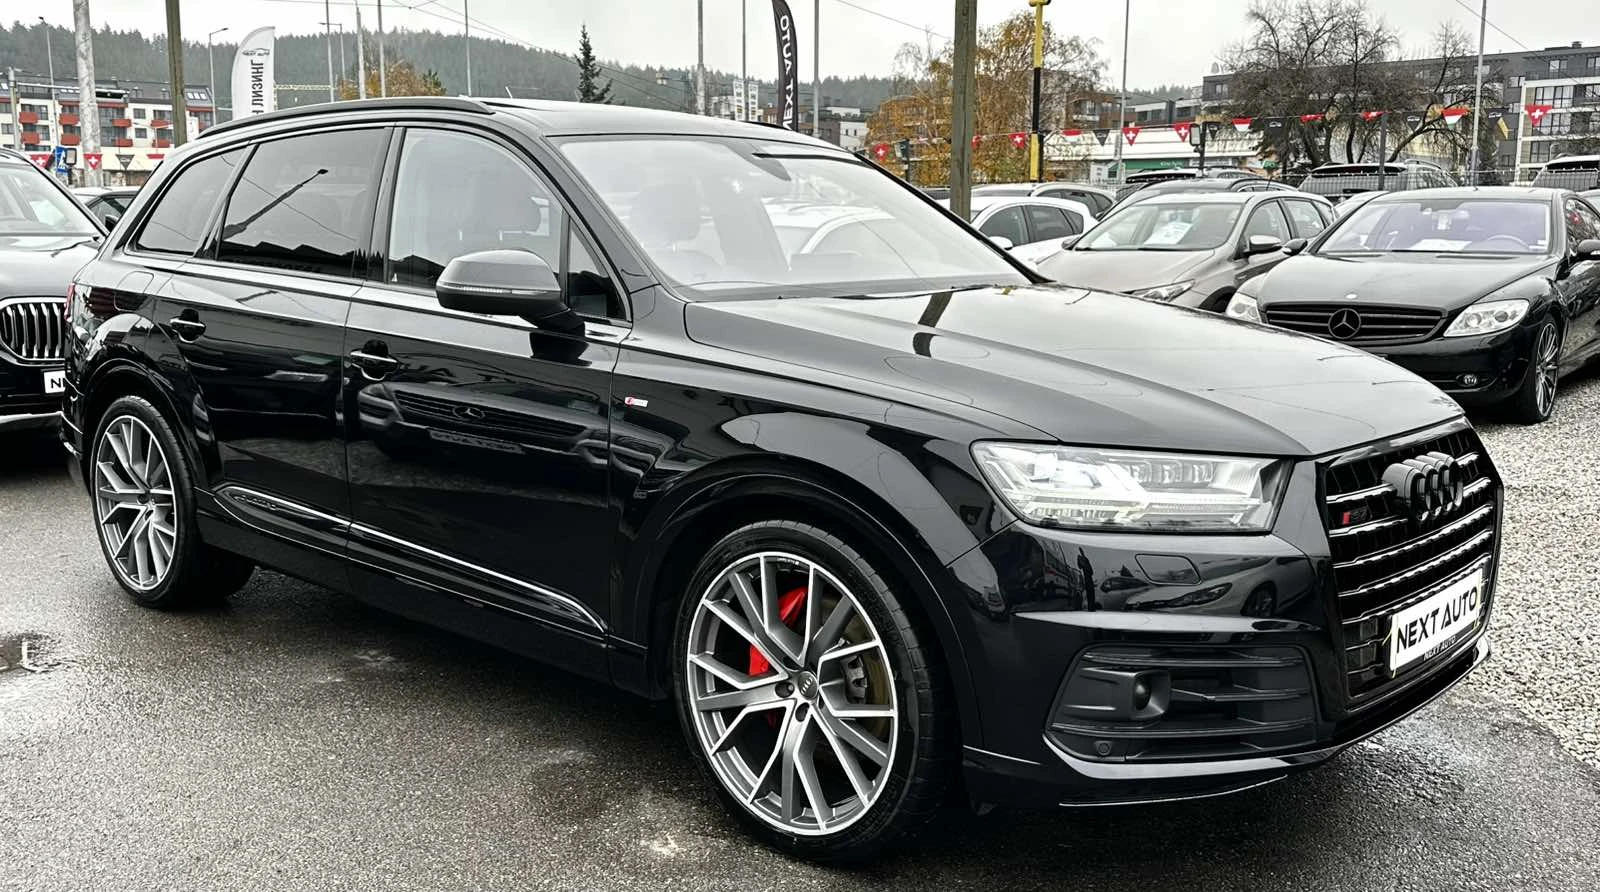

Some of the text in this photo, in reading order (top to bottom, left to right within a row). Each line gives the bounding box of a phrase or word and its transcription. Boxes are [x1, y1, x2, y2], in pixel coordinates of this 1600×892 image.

[250, 60, 264, 107] ЛИЗИНГ
[1397, 586, 1478, 654] NEXT AUTO
